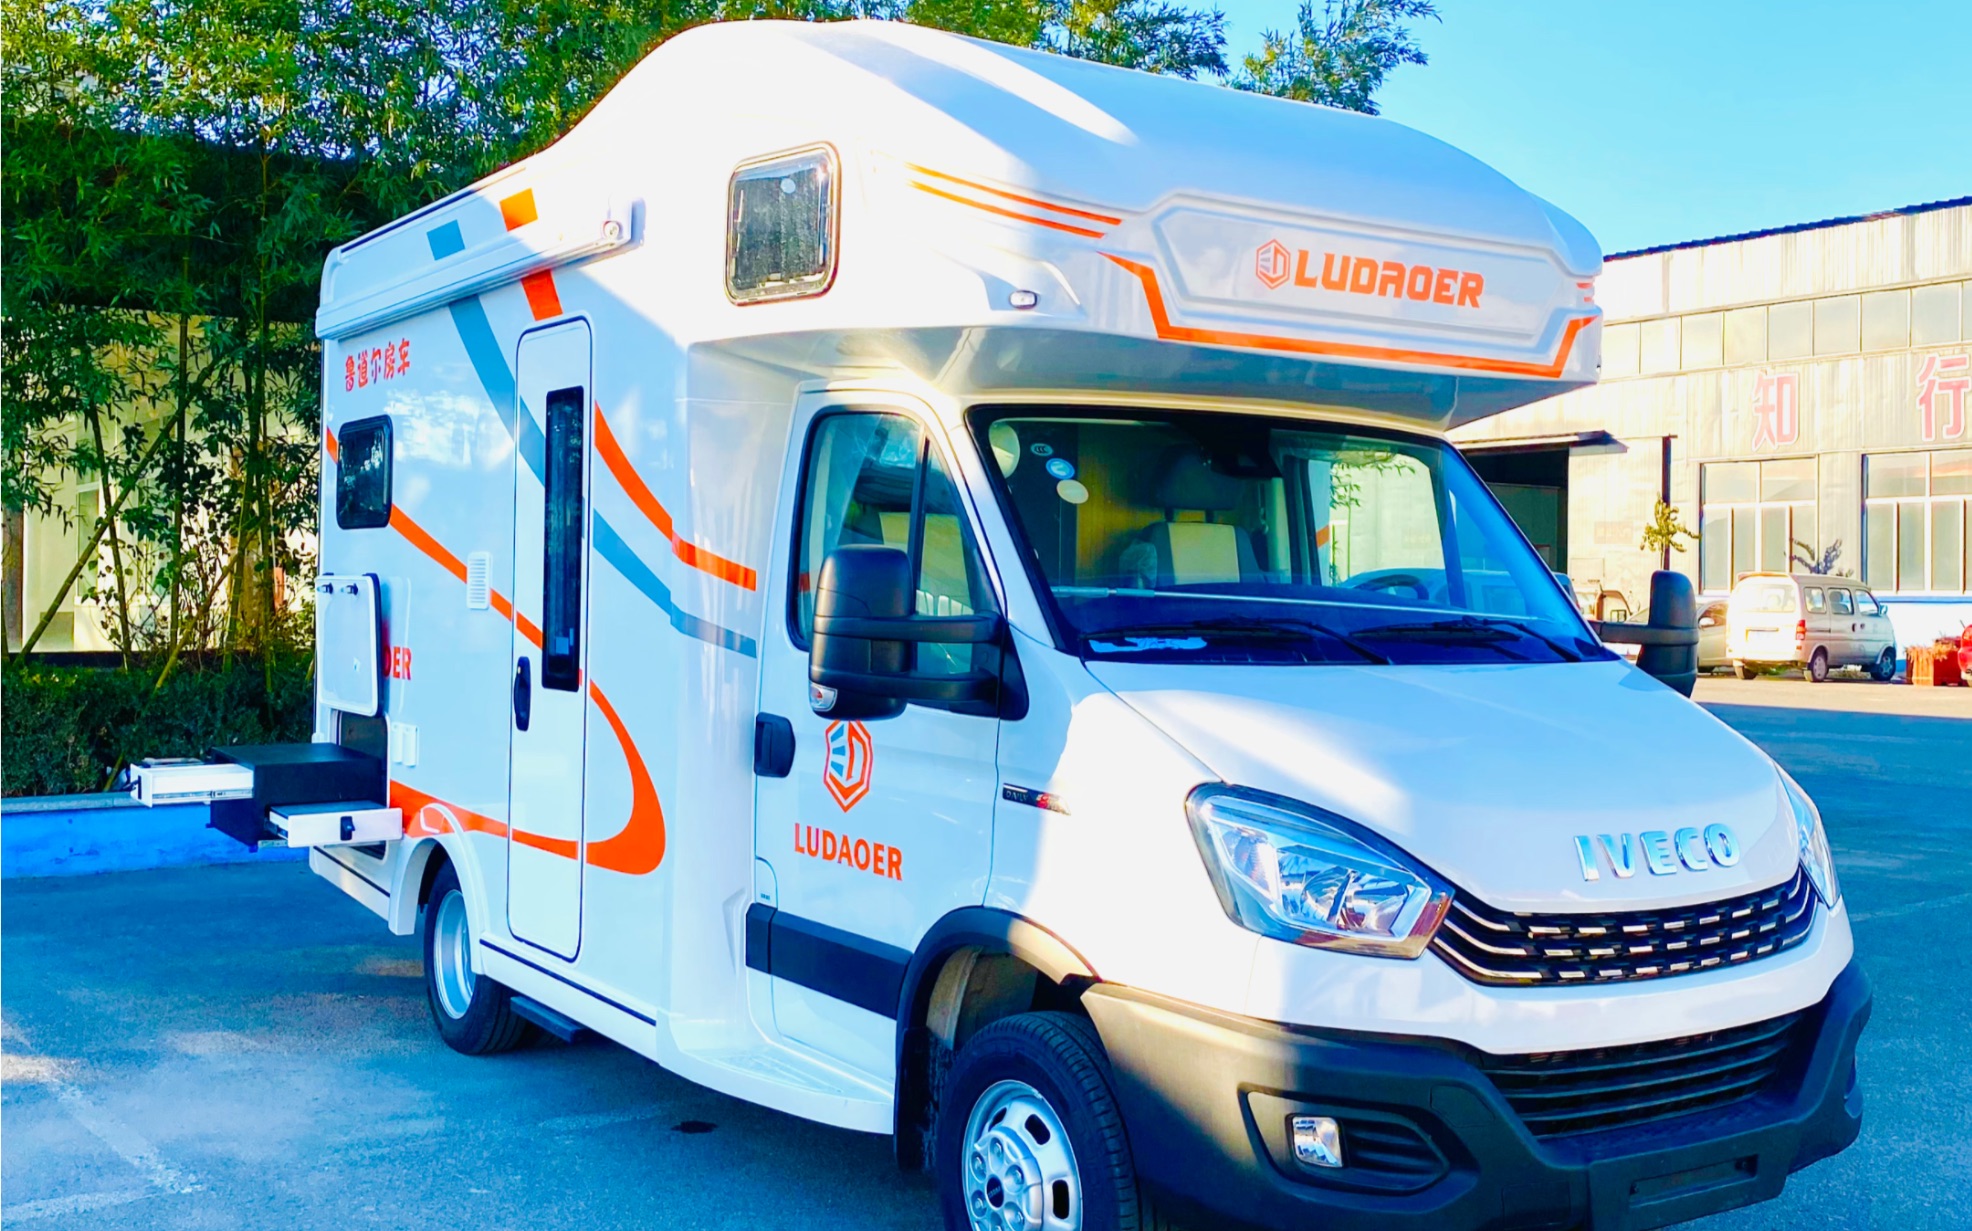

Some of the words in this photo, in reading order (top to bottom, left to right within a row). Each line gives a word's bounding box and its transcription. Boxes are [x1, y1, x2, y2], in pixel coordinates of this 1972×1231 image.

[1294, 249, 1484, 308] LUDAOER
[345, 338, 410, 392] 鲁道尔房车
[794, 823, 903, 881] LUDAOER
[1574, 823, 1741, 881] IVECO
